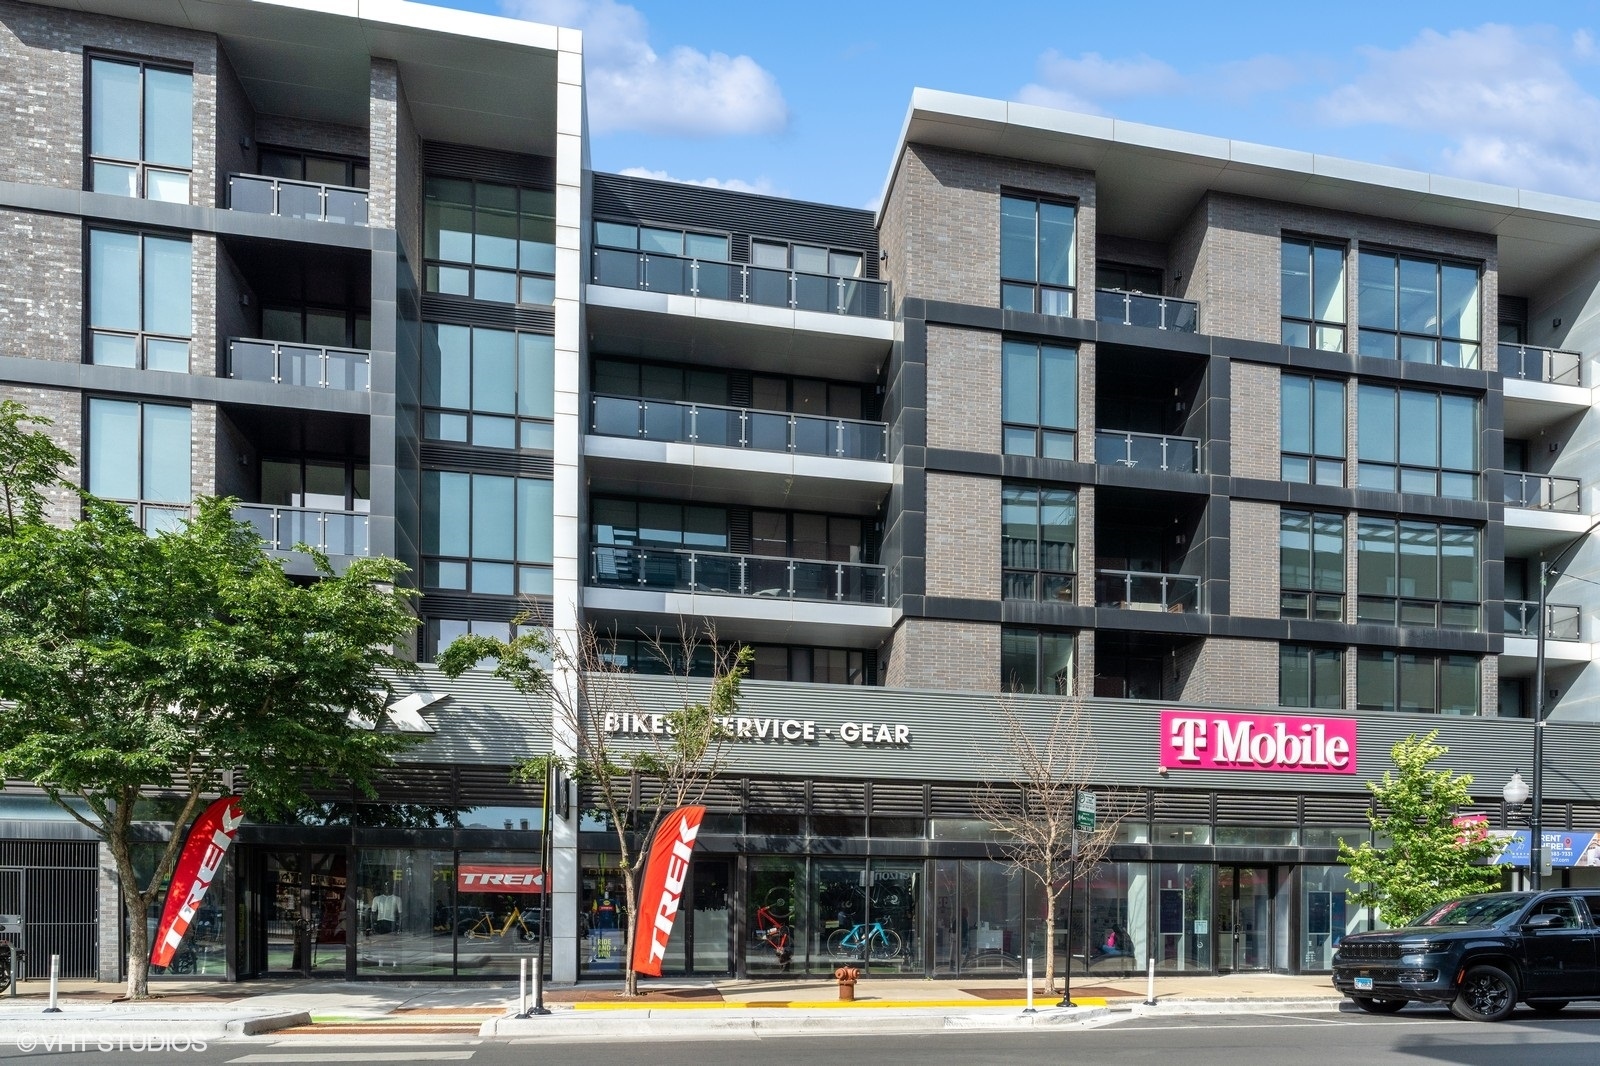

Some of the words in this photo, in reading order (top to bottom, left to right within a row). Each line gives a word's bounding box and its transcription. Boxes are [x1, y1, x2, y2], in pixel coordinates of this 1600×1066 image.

[604, 713, 680, 734] BIKES
[840, 722, 909, 743] GEAR
[1212, 719, 1349, 767] Mobile
[1541, 834, 1561, 842] RENT
[160, 804, 245, 954] TREK
[460, 873, 543, 885] TREK
[649, 815, 700, 964] TREK
